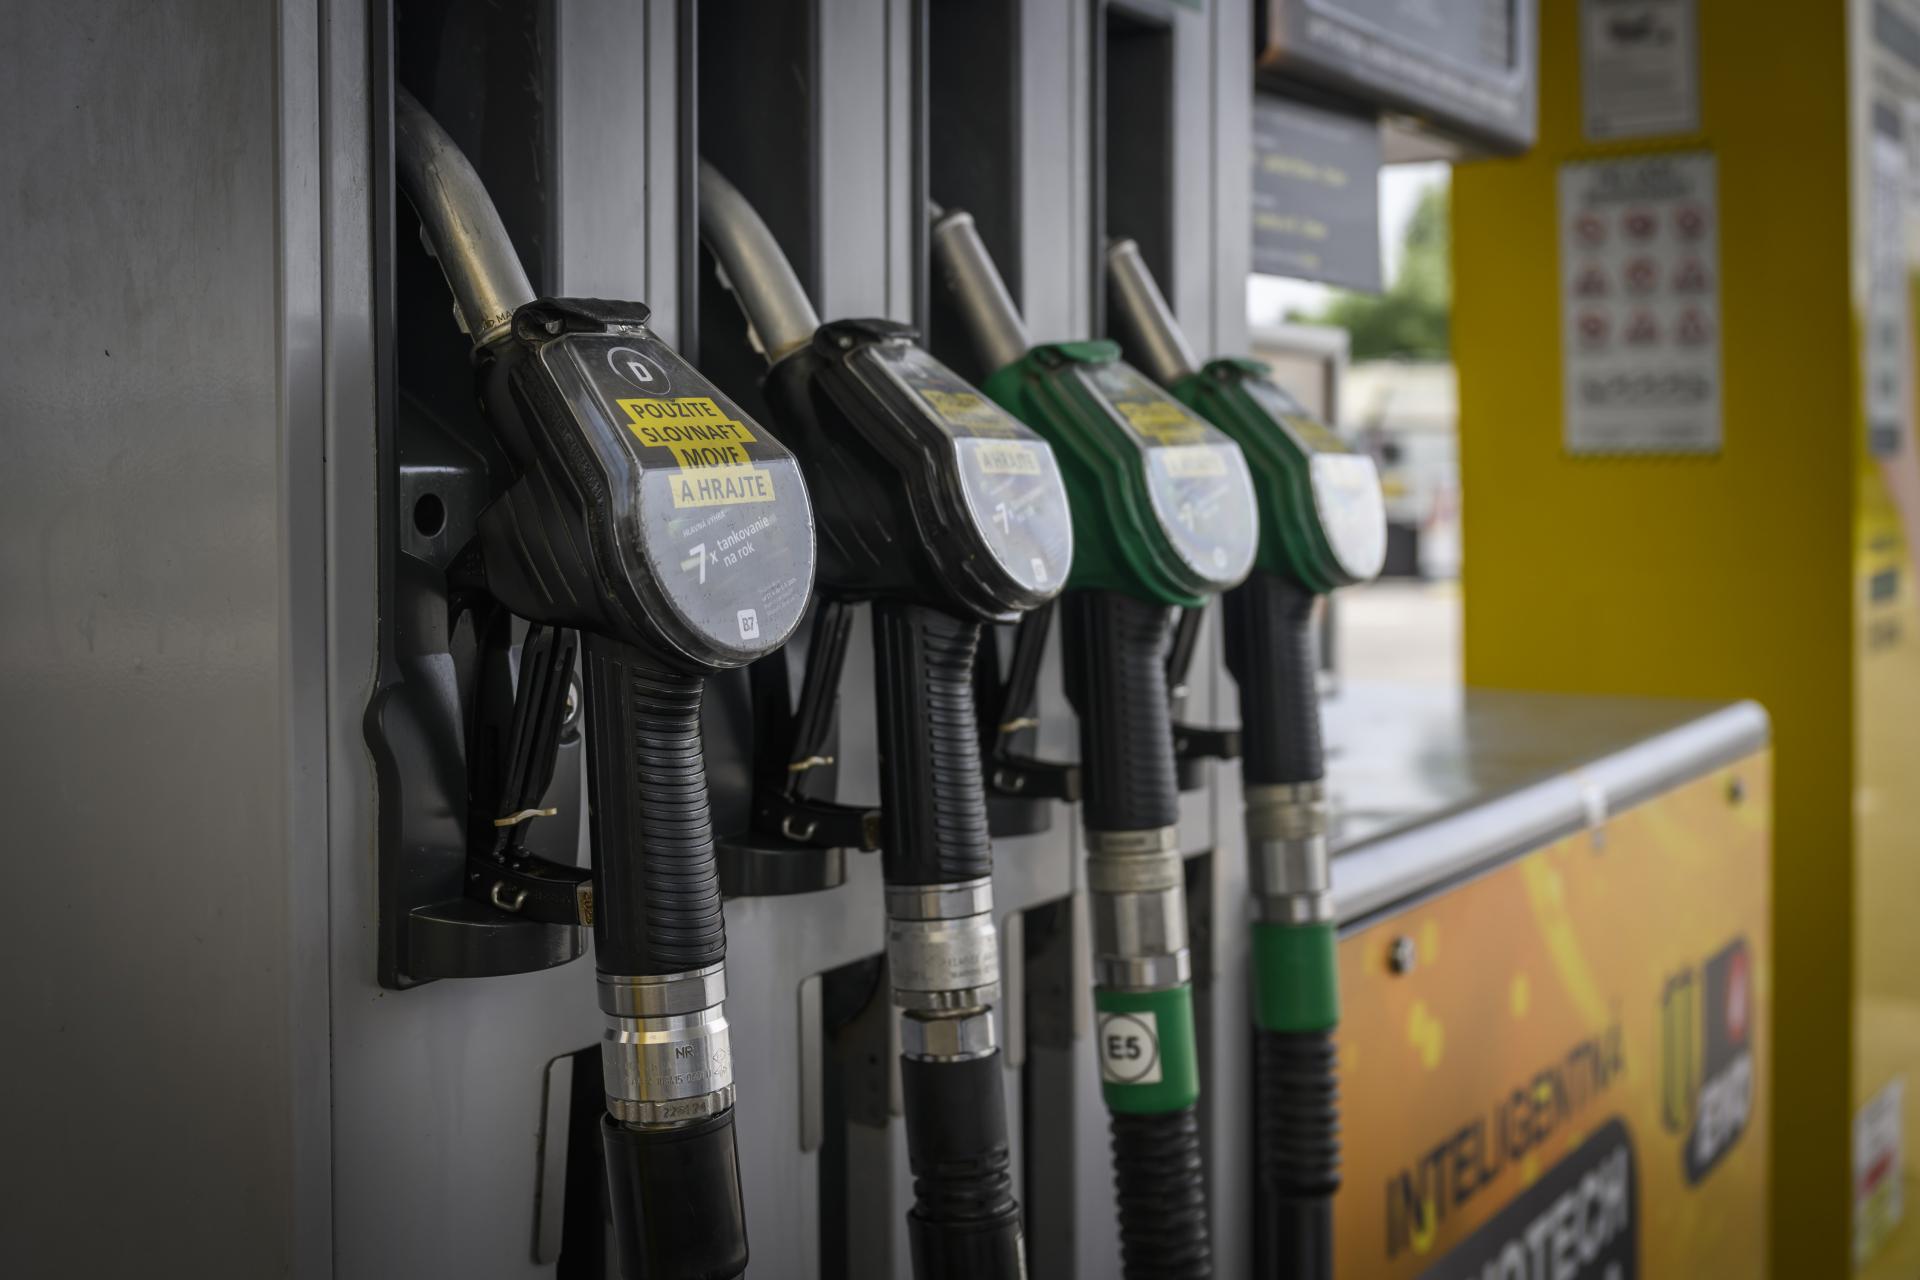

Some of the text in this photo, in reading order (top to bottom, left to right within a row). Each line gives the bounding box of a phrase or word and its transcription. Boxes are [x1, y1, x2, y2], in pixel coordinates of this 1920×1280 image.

[626, 361, 654, 382] D
[630, 400, 718, 419] POUŽITE
[640, 424, 742, 443] SLOVNAFT
[680, 446, 744, 469] MOVE
[682, 475, 767, 502] A HRAJTE
[716, 515, 770, 552] tankovanie
[682, 543, 706, 585] 7
[723, 541, 756, 567] na rok
[1107, 1035, 1142, 1060] E5
